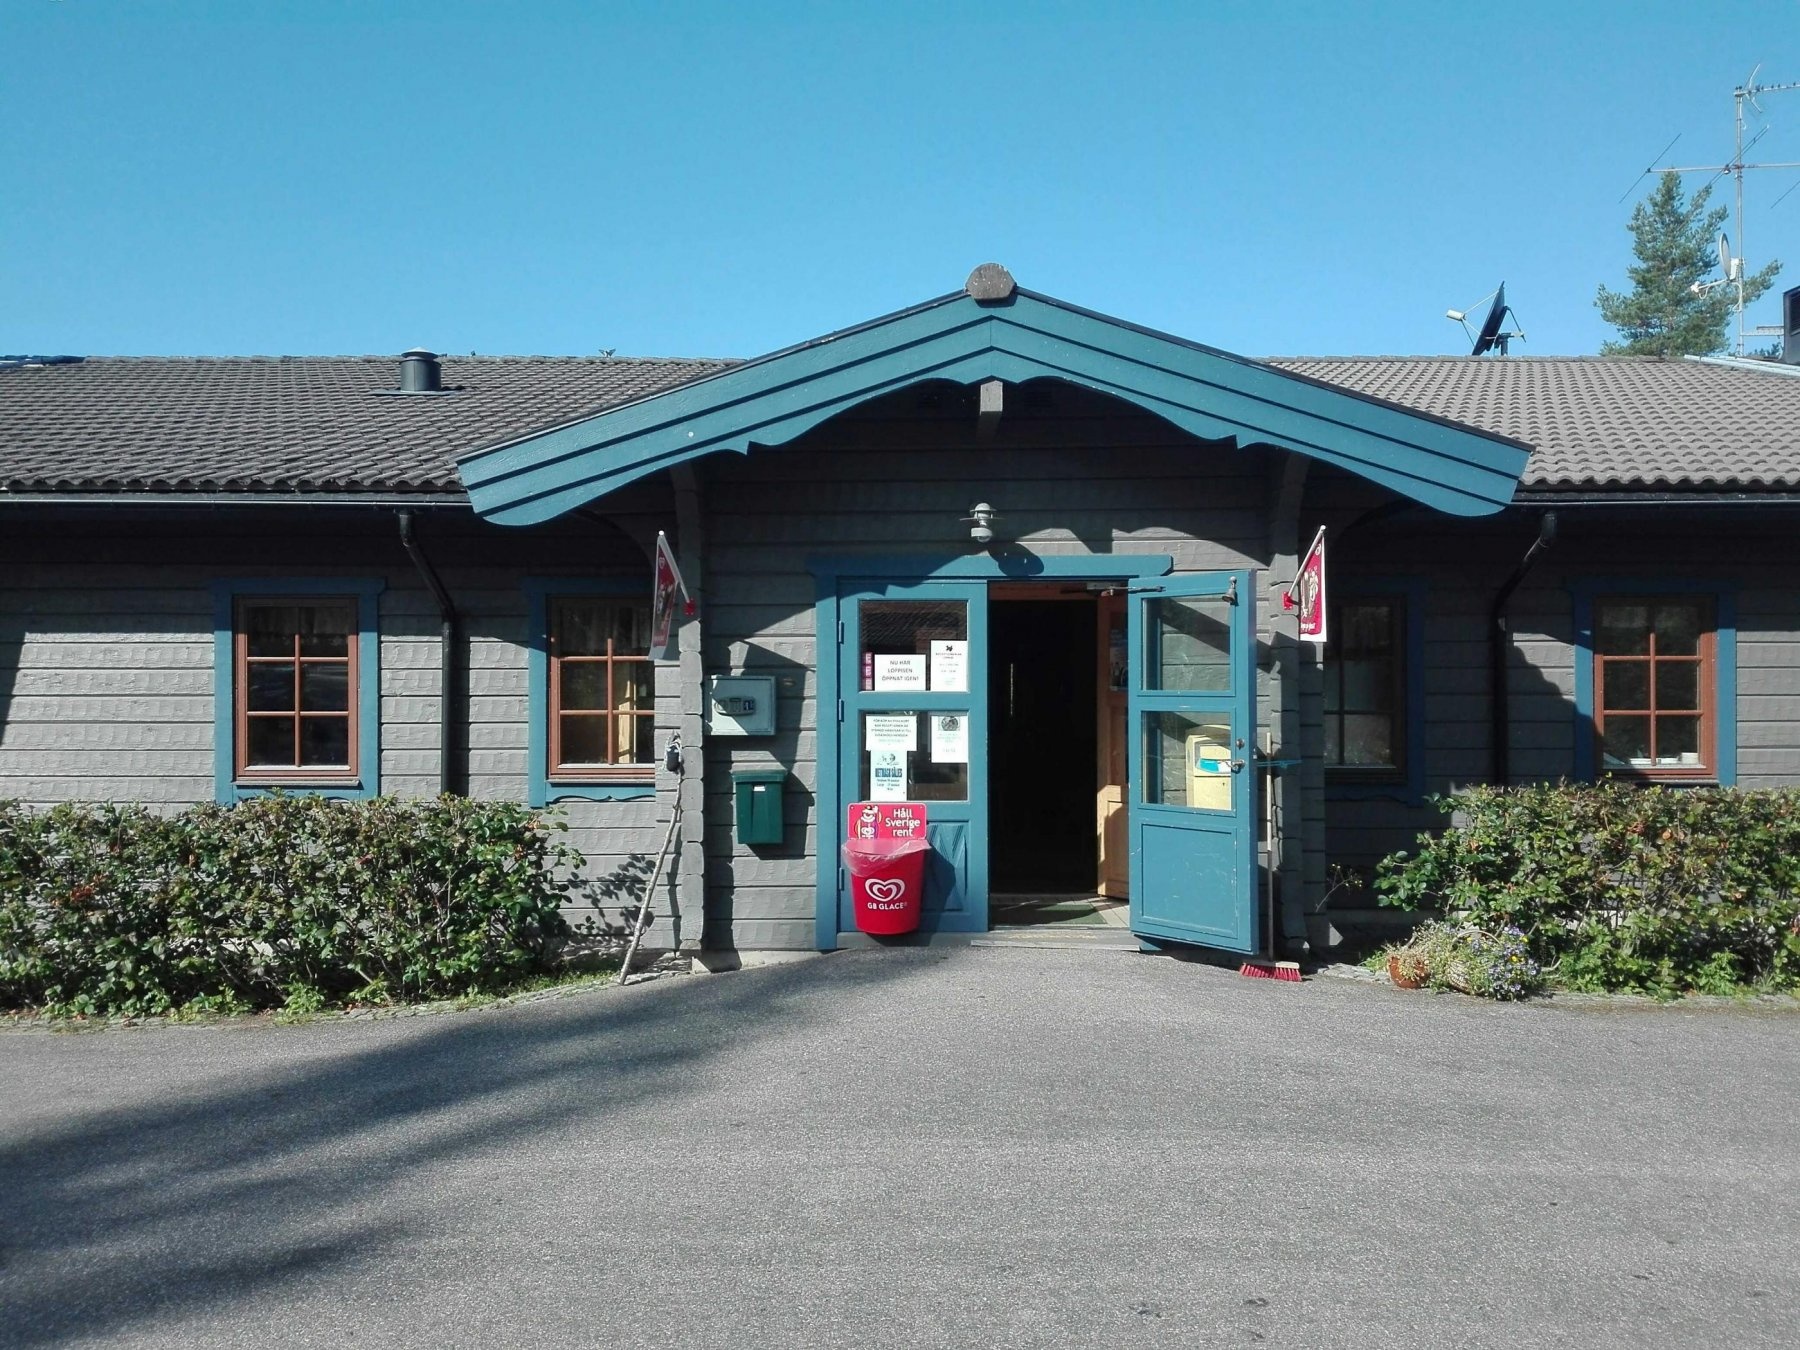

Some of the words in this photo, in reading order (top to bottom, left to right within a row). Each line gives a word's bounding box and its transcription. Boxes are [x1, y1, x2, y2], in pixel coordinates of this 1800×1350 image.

[893, 807, 913, 818] Håll
[885, 818, 921, 829] Sverige
[892, 828, 914, 837] rent
[867, 902, 878, 910] GB
